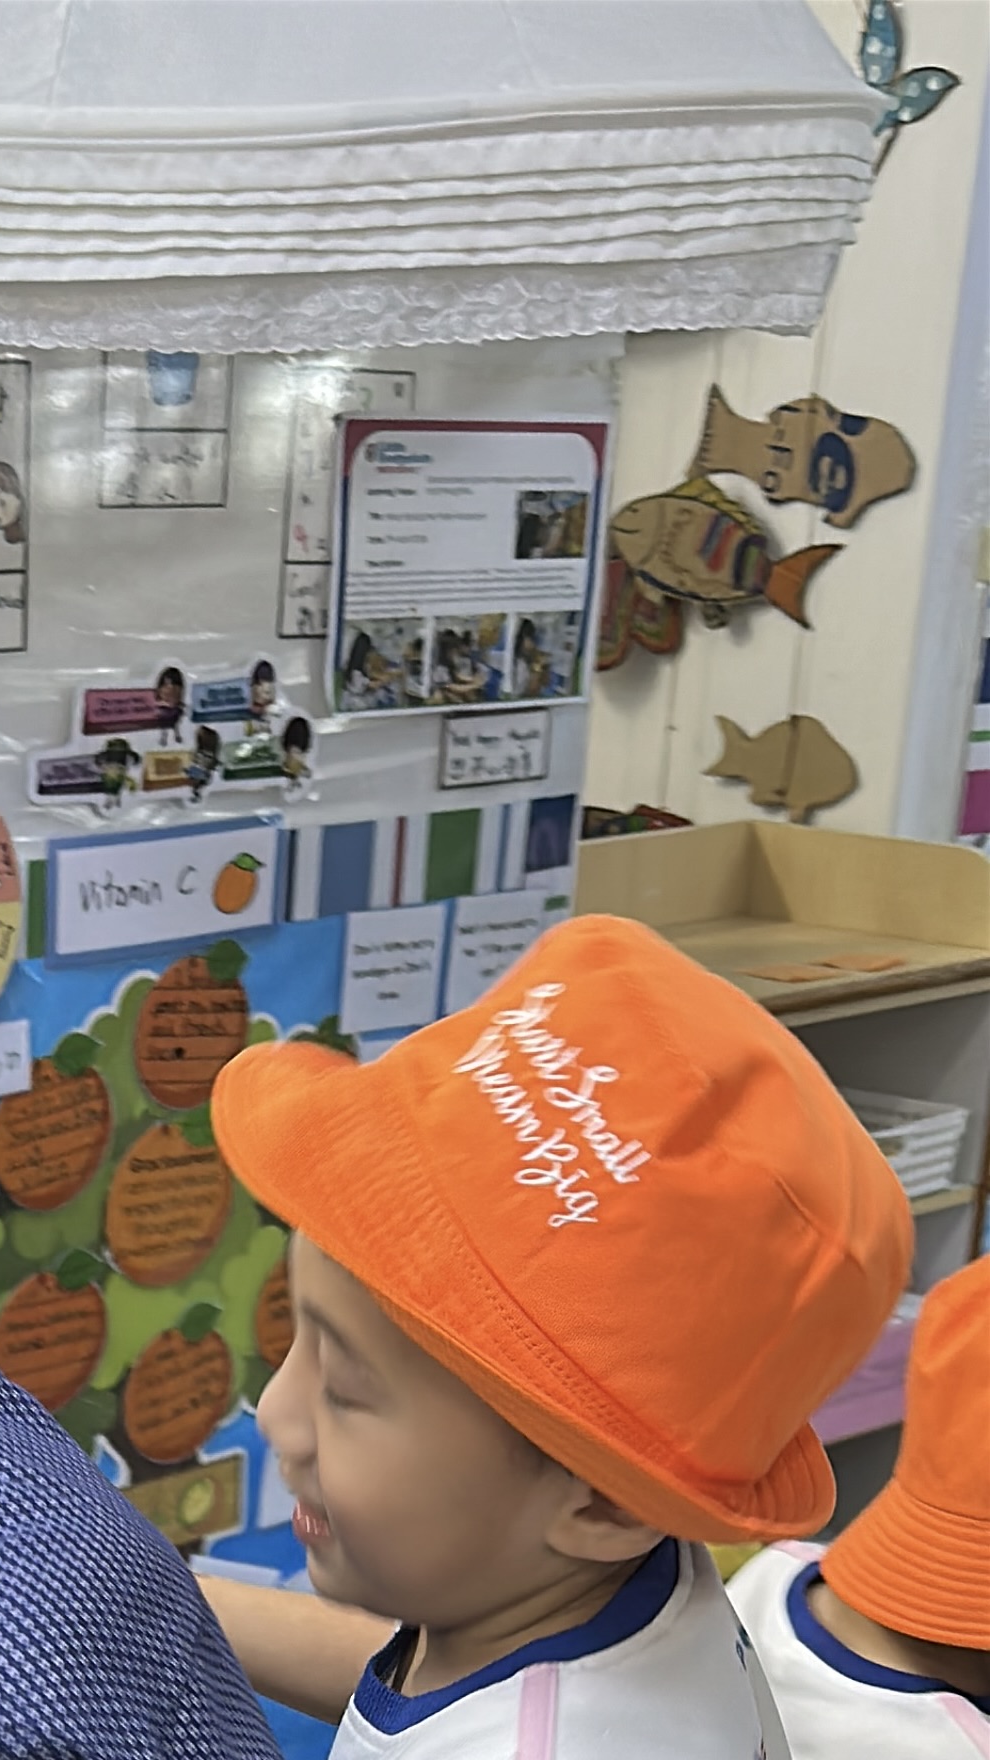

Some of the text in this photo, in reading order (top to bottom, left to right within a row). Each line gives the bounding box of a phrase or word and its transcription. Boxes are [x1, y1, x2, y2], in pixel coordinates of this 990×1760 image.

[78, 864, 198, 913] Vitamin C
[450, 1023, 544, 1143] Dream
[513, 1127, 600, 1228] Big
[542, 1064, 653, 1185] Small
